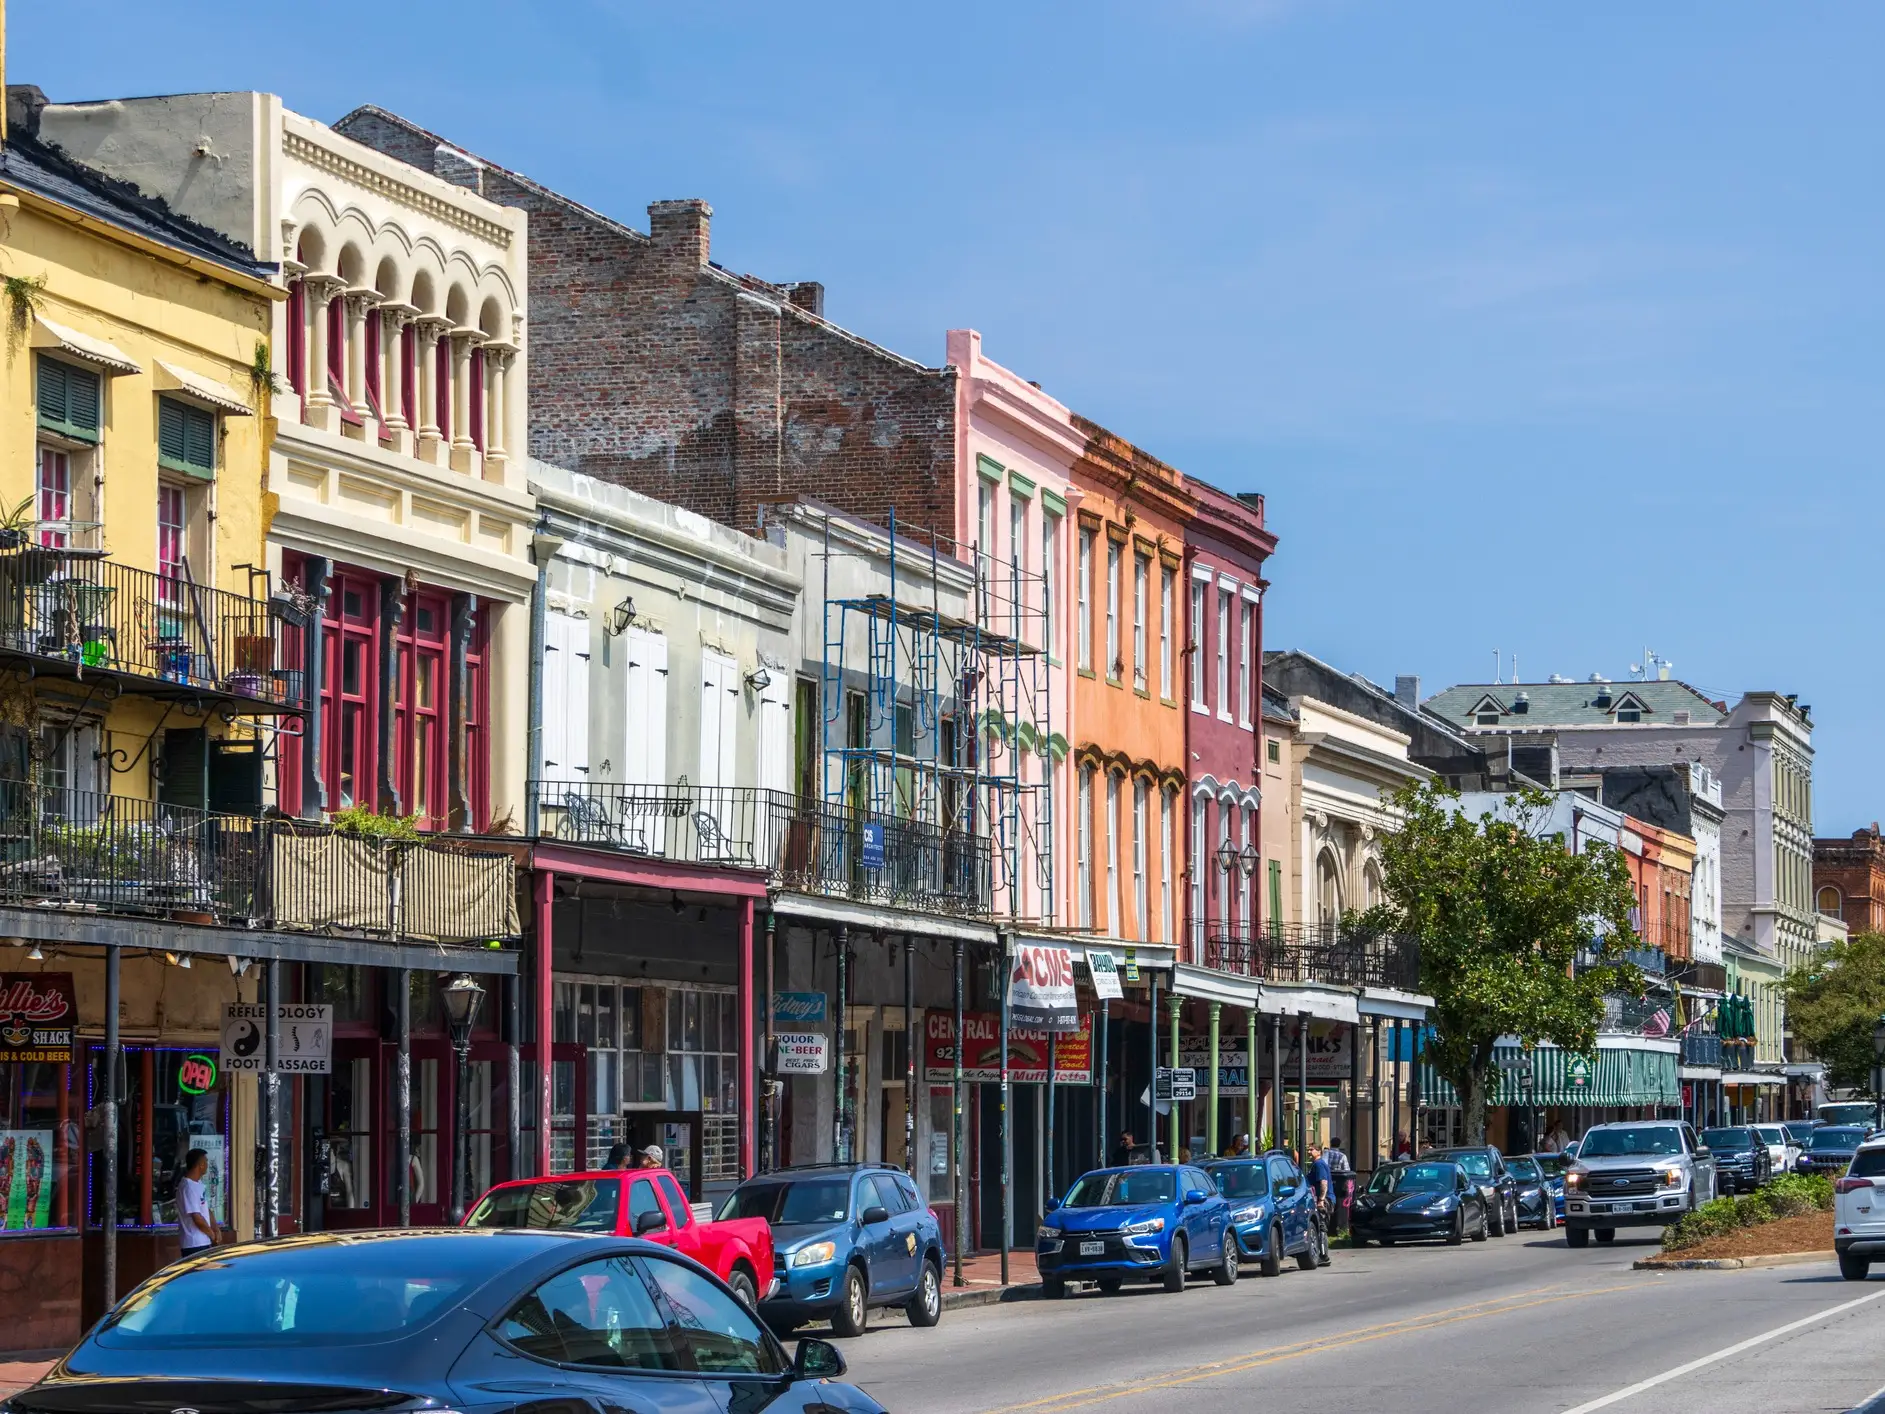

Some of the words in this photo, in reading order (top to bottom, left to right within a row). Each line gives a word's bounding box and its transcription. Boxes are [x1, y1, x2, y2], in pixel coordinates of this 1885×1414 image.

[1012, 947, 1074, 987] ACMS
[1090, 953, 1117, 973] BAYOU
[0, 980, 69, 1021] illie's
[228, 1006, 326, 1019] REFLEOLOGY
[929, 1014, 995, 1039] CENRAL
[33, 1031, 71, 1045] SHACK
[779, 1034, 815, 1044] IQUOR
[11, 1052, 17, 1060] &
[20, 1052, 45, 1061] COLD
[47, 1052, 70, 1061] BEER
[936, 1046, 955, 1060] 92
[226, 1059, 260, 1069] FOOT
[264, 1060, 326, 1071] ASSAGE
[1058, 1060, 1086, 1069] Foods
[182, 1060, 212, 1090] OPEN
[929, 1068, 951, 1077] Home
[963, 1070, 974, 1078] the
[977, 1070, 1010, 1080] Originl
[1013, 1070, 1088, 1082] Muffletta
[1195, 1069, 1249, 1086] NERAL
